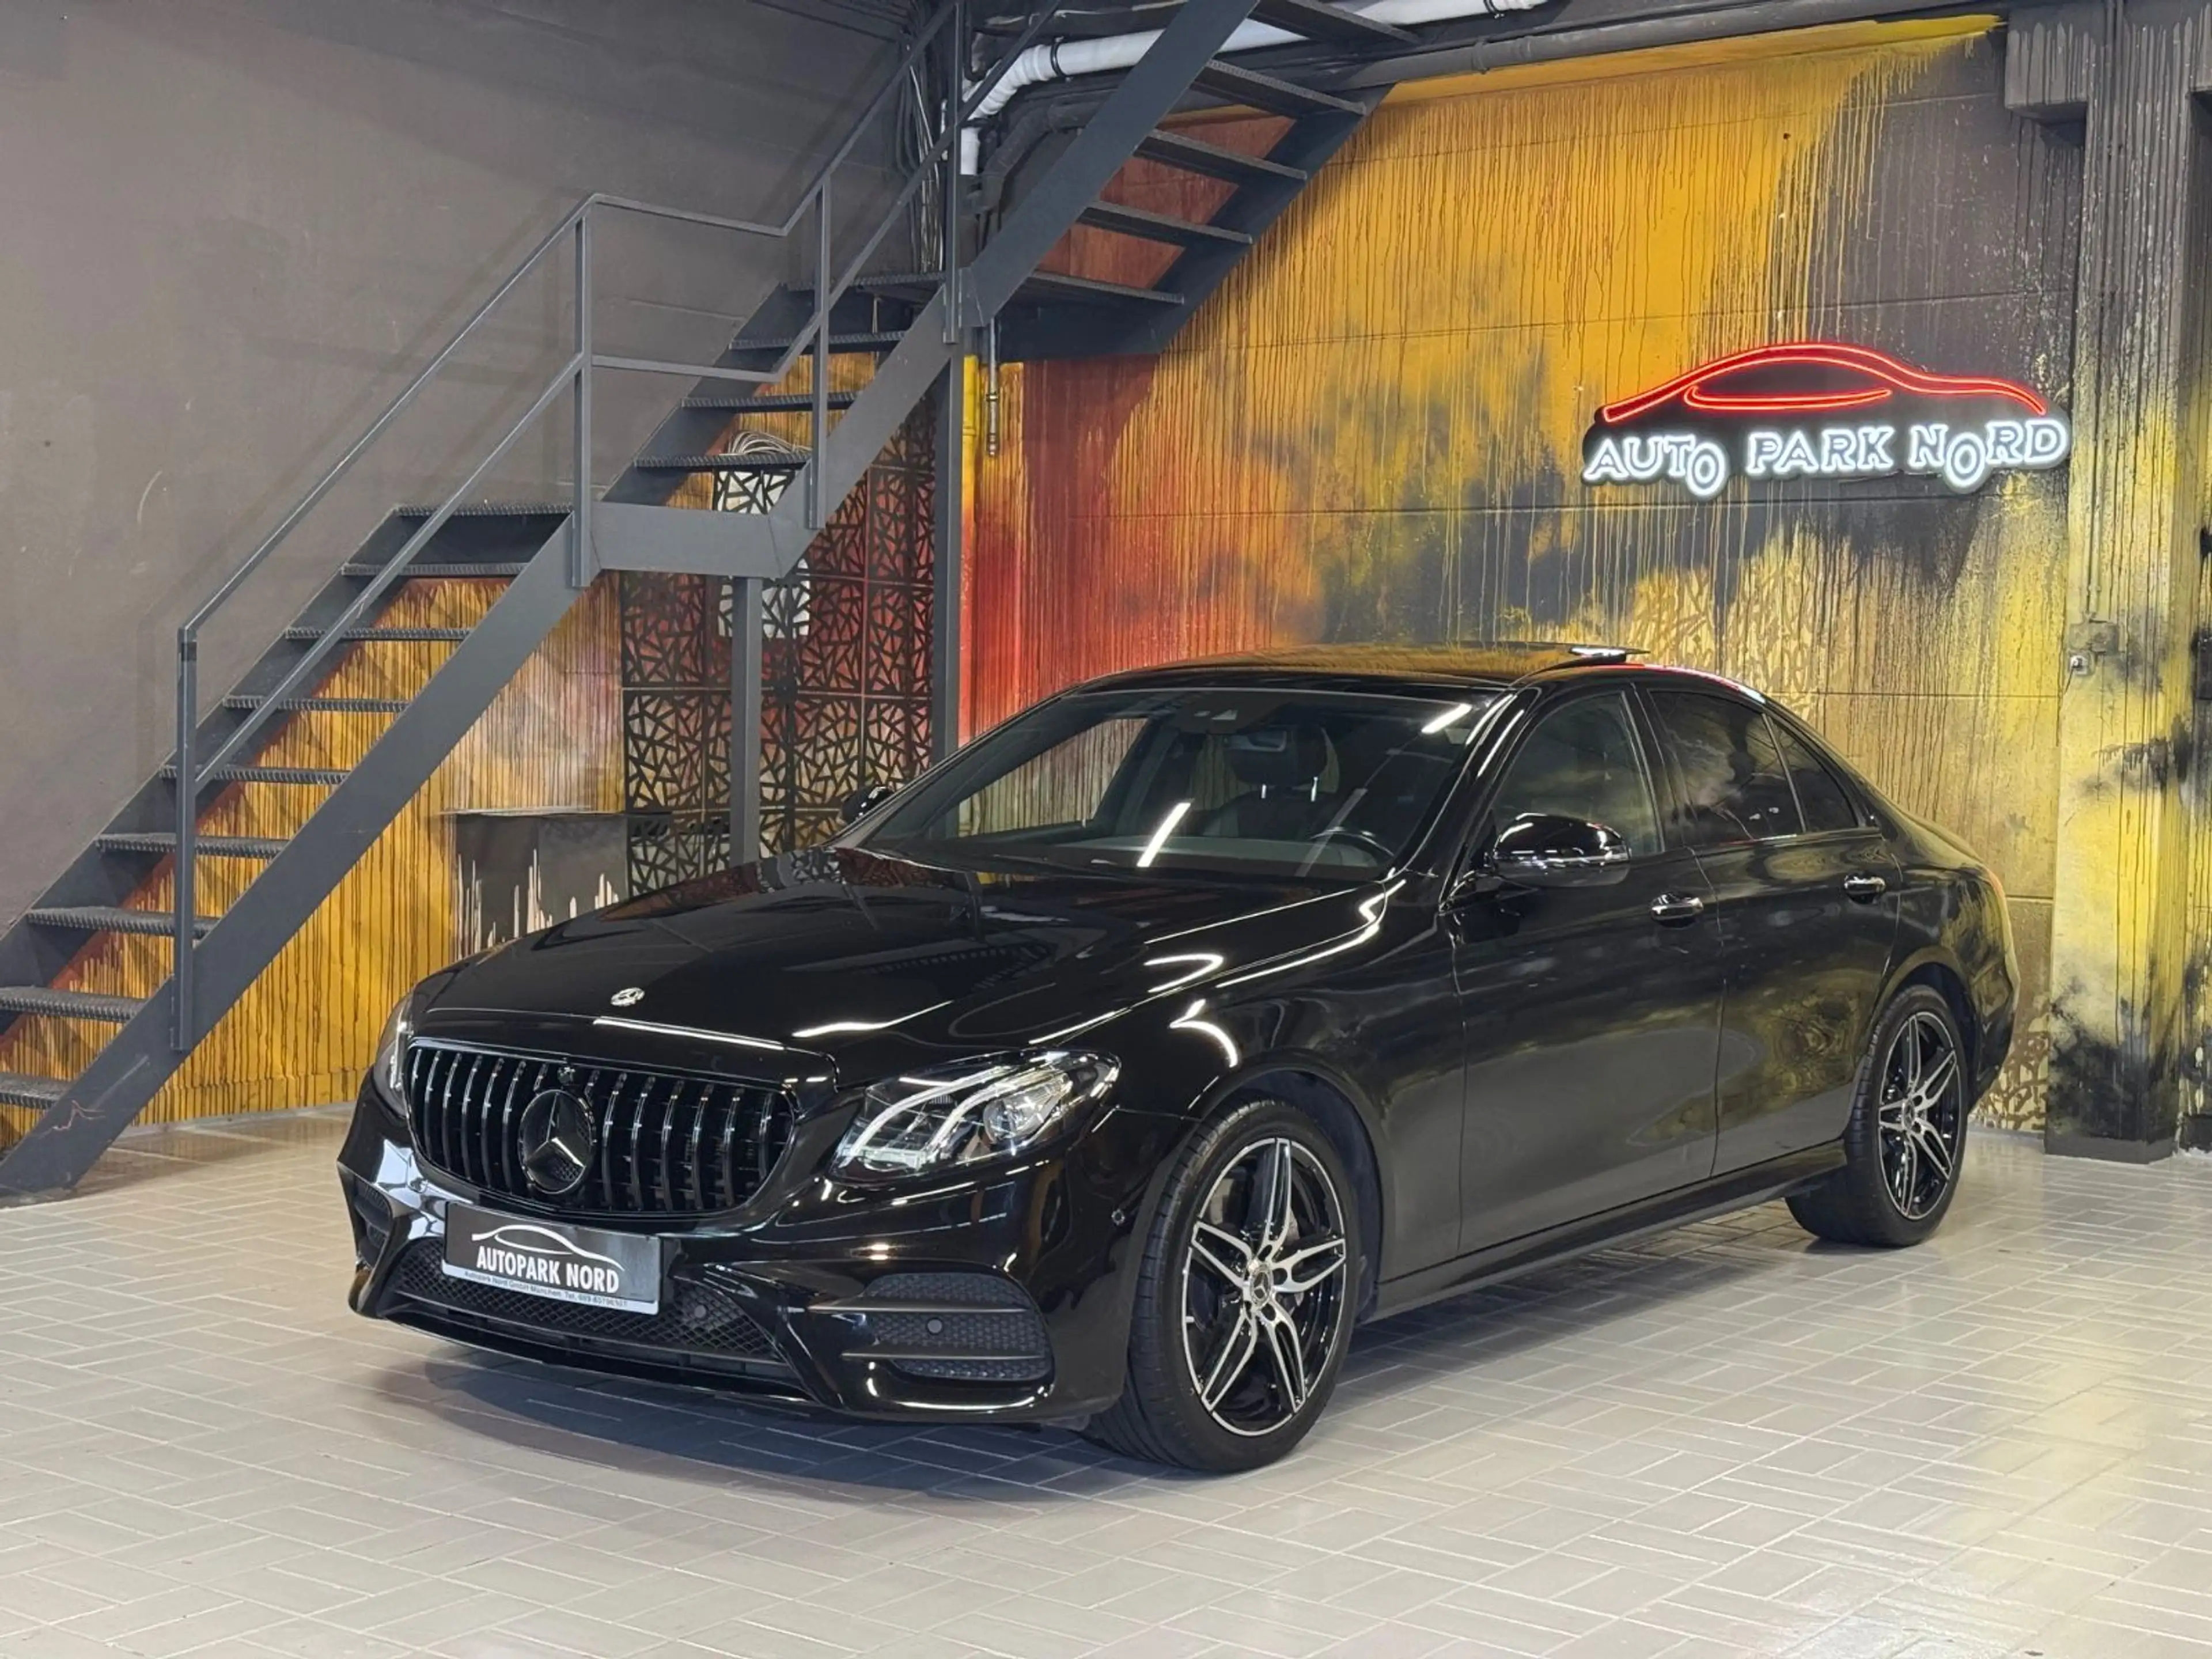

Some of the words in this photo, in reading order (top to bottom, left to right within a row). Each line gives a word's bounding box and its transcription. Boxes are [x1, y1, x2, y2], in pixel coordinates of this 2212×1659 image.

[1583, 434, 1729, 495] AUTO
[1747, 425, 1896, 476] PARK
[1908, 417, 2071, 494] NORD
[476, 1246, 560, 1285] AUTOPARK
[566, 1263, 619, 1293] NORD
